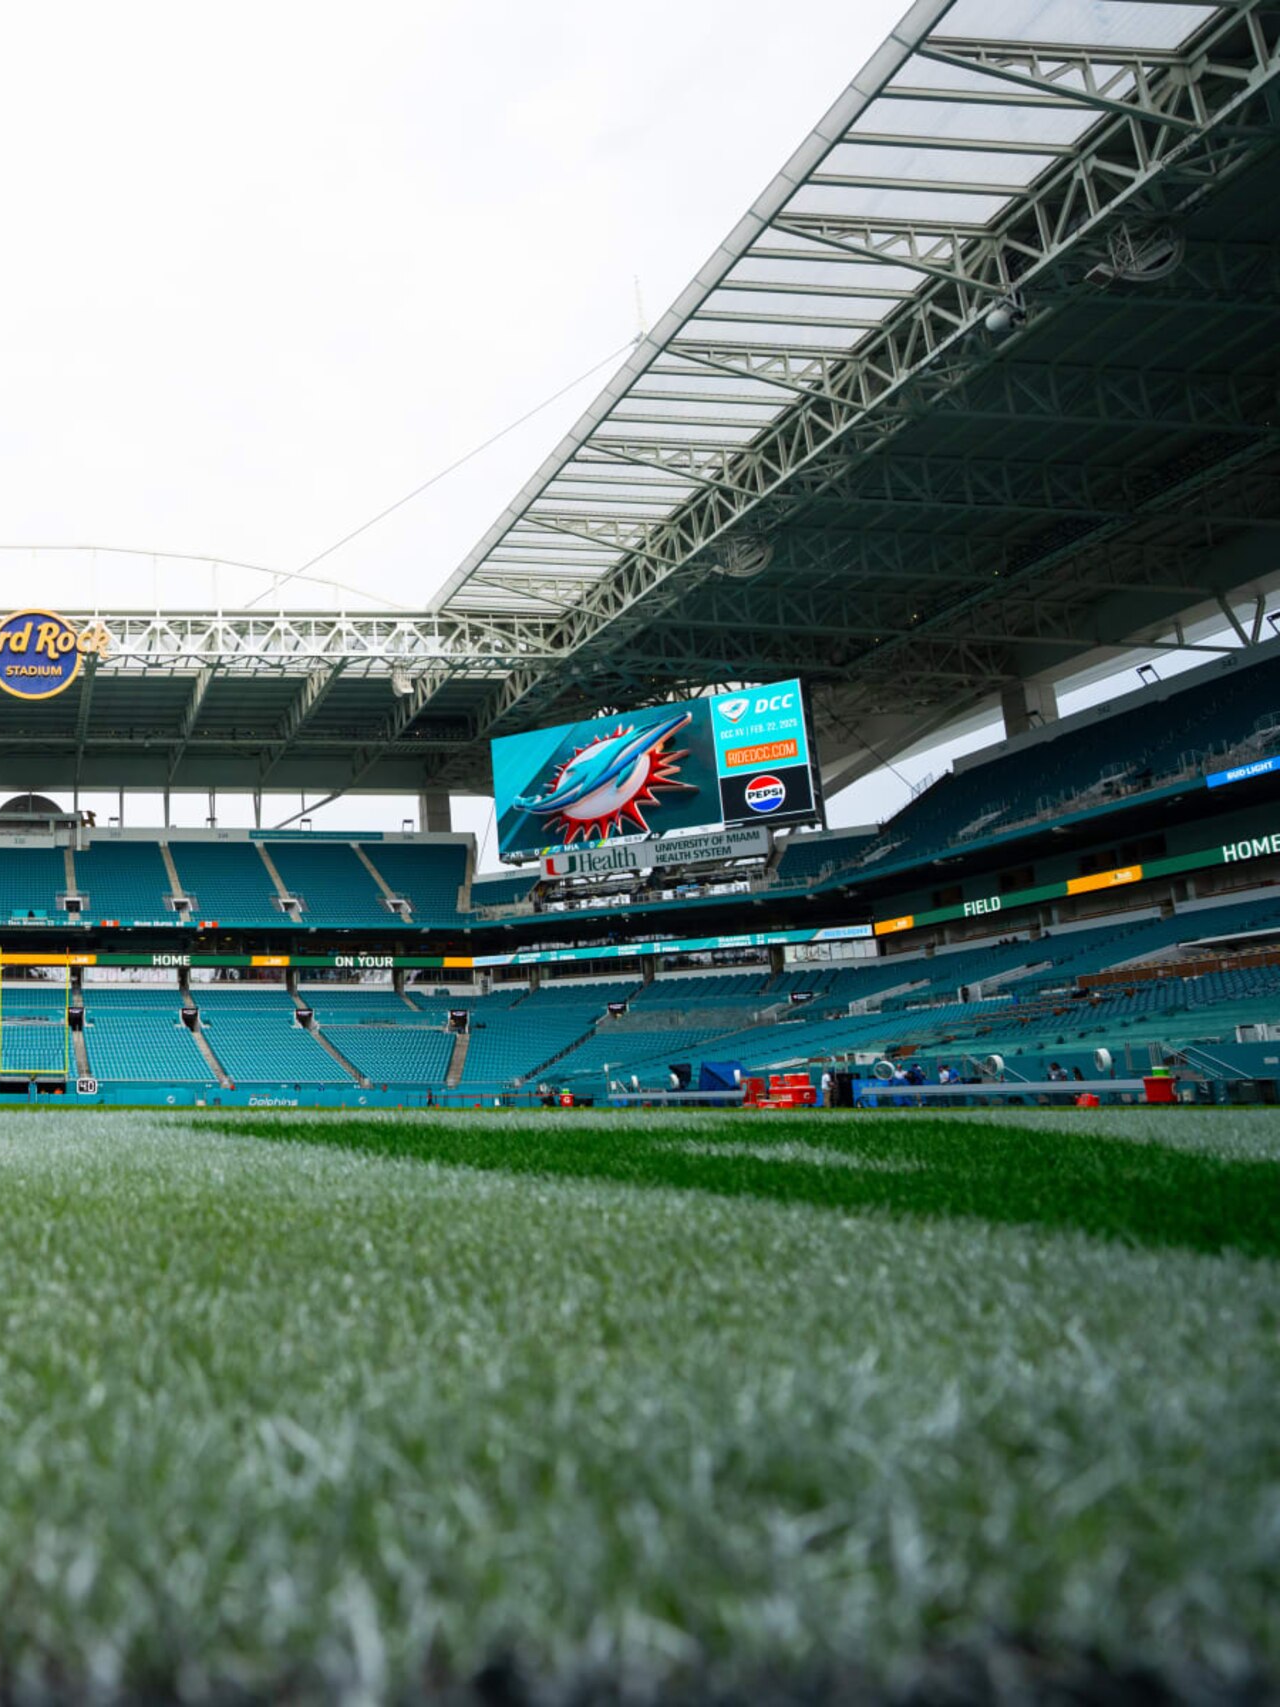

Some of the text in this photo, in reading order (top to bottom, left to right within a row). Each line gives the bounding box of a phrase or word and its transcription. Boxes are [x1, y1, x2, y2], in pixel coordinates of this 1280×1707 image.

[35, 621, 111, 659] Rock
[5, 665, 62, 676] STADIUM
[754, 693, 794, 714] DCC
[727, 742, 795, 765] RIDEDCC.COM
[1247, 760, 1274, 776] LIGHT
[747, 787, 783, 800] PEPSI
[655, 838, 709, 853] UNIVERSITY
[711, 835, 724, 846] OF
[726, 830, 760, 844] MIAMI
[1222, 833, 1280, 863] HOME
[656, 847, 732, 864] HEALTH SYSTEM
[964, 896, 1001, 917] FIELD
[153, 954, 191, 966] HOME
[335, 956, 393, 968] ON YOUR
[78, 1080, 95, 1093] 40
[248, 1097, 298, 1107] Dolphins
